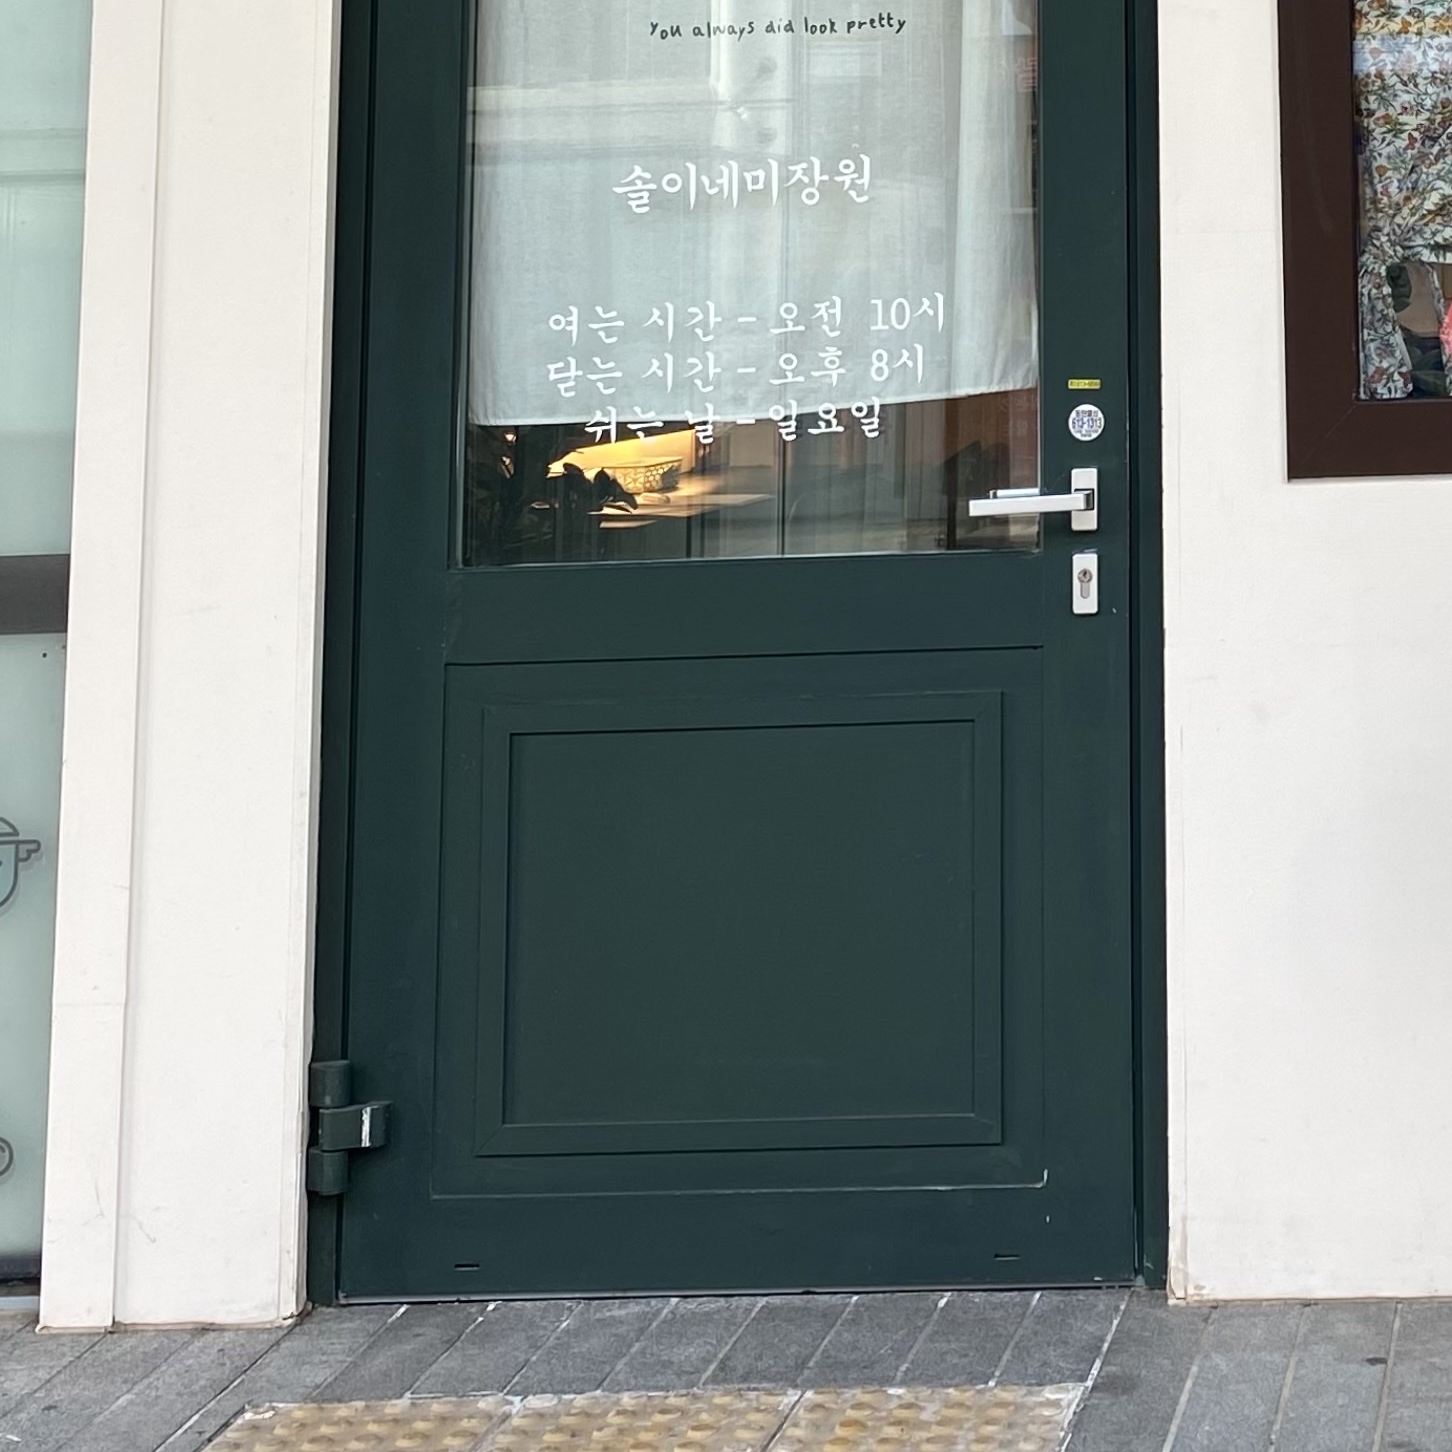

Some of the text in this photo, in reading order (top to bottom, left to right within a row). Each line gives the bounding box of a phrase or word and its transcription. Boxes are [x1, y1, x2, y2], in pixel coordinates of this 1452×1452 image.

[692, 20, 756, 42] always
[765, 17, 796, 35] did
[804, 16, 838, 36] look
[846, 12, 907, 35] pretty
[612, 153, 872, 214] 솔이네미장원
[548, 305, 625, 346] 여는
[642, 300, 722, 342] 시간
[769, 295, 842, 338] 오전
[870, 291, 944, 333] 10시
[547, 356, 623, 398] 닫는
[641, 351, 722, 393] 시간
[769, 345, 847, 387] 오후
[870, 343, 923, 384] 8시
[584, 405, 664, 442] 쉬는
[768, 396, 881, 442] 일요일
